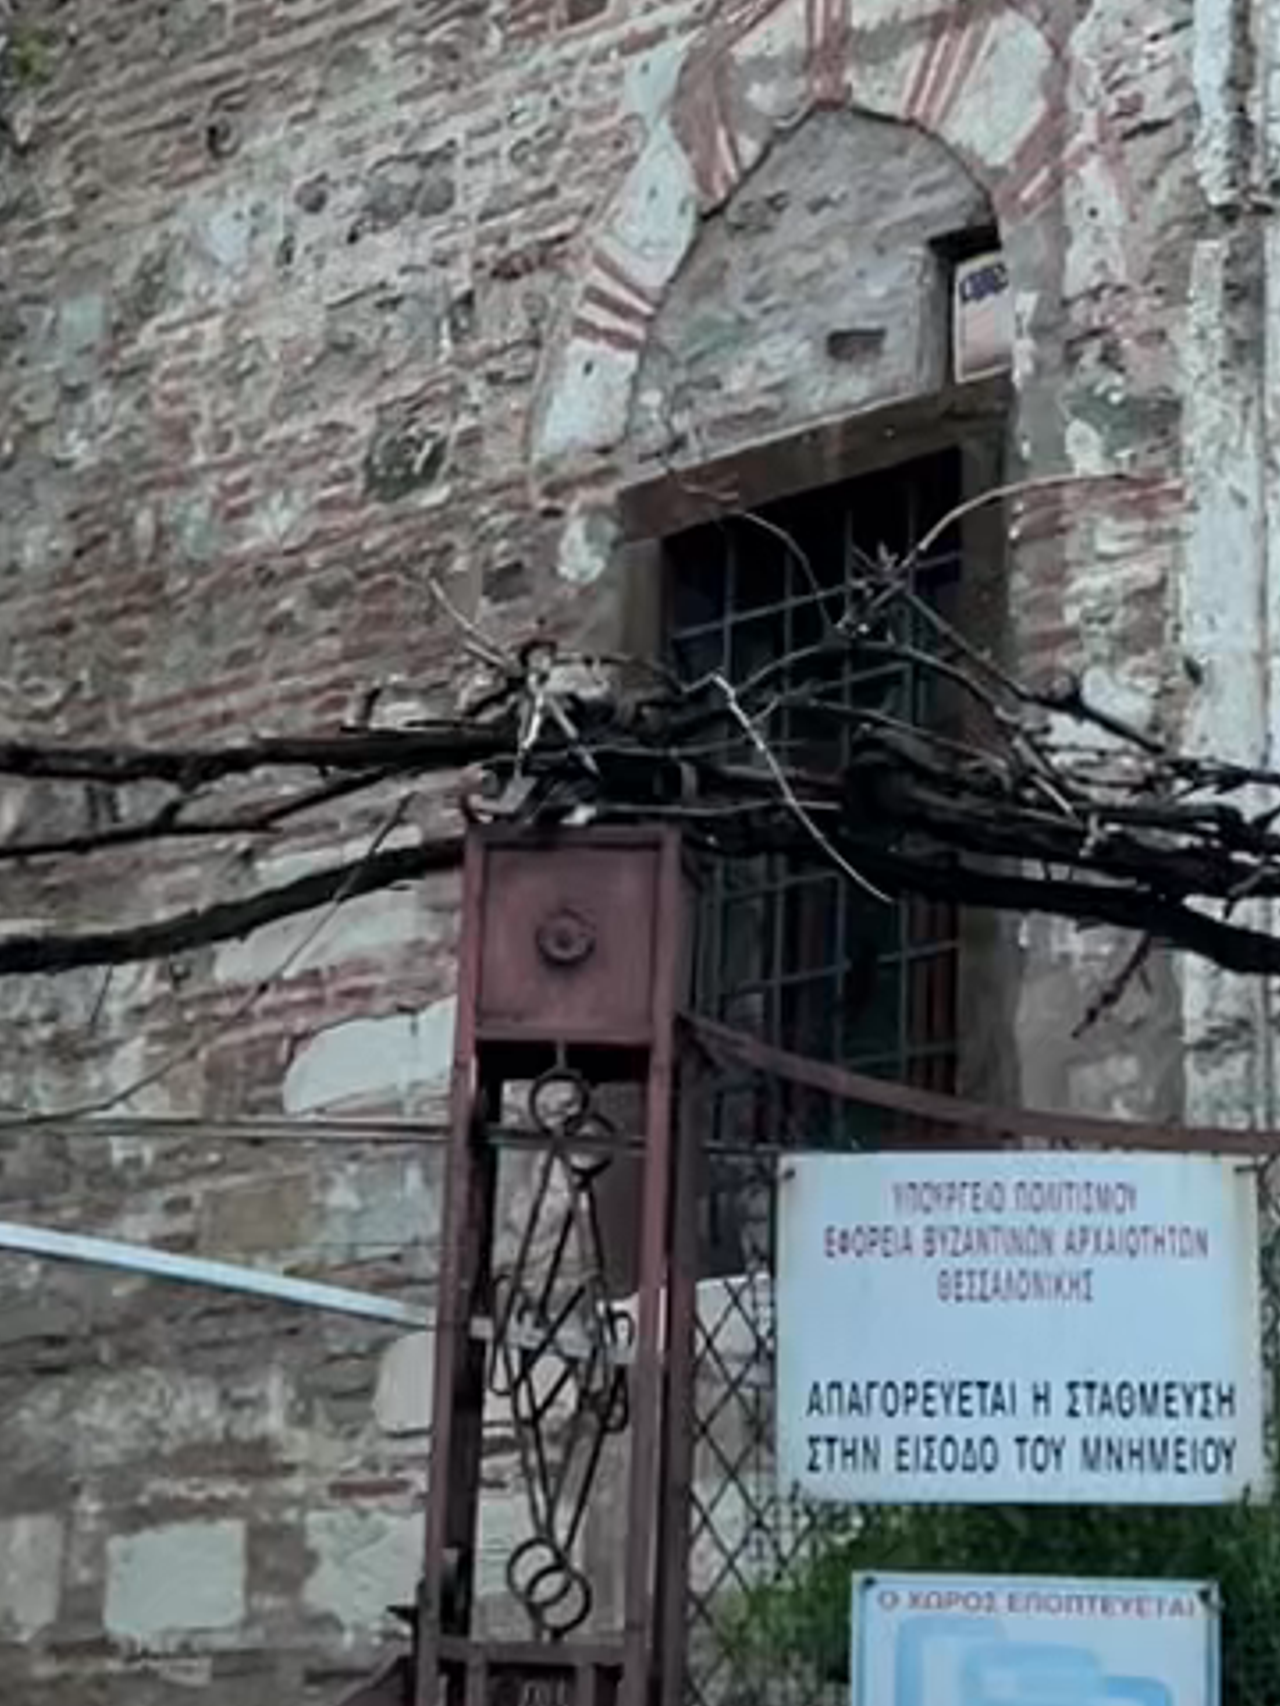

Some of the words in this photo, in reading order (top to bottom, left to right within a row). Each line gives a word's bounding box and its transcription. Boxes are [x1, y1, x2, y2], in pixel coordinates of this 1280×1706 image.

[891, 1181, 1004, 1213] ΥΠΟΥΡΓΕΙΟ
[1015, 1181, 1138, 1213] ΠΟΛΙΤΙΣΜΟΥ
[823, 1225, 913, 1258] ΕΦΟΡΕΙΑ
[923, 1225, 1054, 1258] ΒΥΖΑΝΤΙΝΩΝ
[1064, 1225, 1209, 1258] ΑΡΧΑΙΟΤΗΤΩΝ
[937, 1268, 1095, 1303] ΘΕΣΣΑΛΟΝΙΚΗΣ
[806, 1380, 1017, 1418] ΑΠΑΓΟΡΕΥΕΤΑΙ
[1032, 1380, 1052, 1418] Η
[1065, 1380, 1237, 1419] ΣΤΑΘΜΕΥΣΗ
[806, 1435, 880, 1474] ΣΤΗΝ
[895, 1435, 1000, 1474] ΕΙΣΟΔΟ
[1013, 1435, 1067, 1474] ΤΟΥ
[1081, 1435, 1237, 1475] ΜΝΗΜΕΙΟΥ
[877, 1589, 900, 1611] Ο
[908, 1589, 998, 1614] ΧΩΡΟΣ
[1008, 1591, 1196, 1618] ΕΠΟΠΤΕΥΕΤΑΙ
